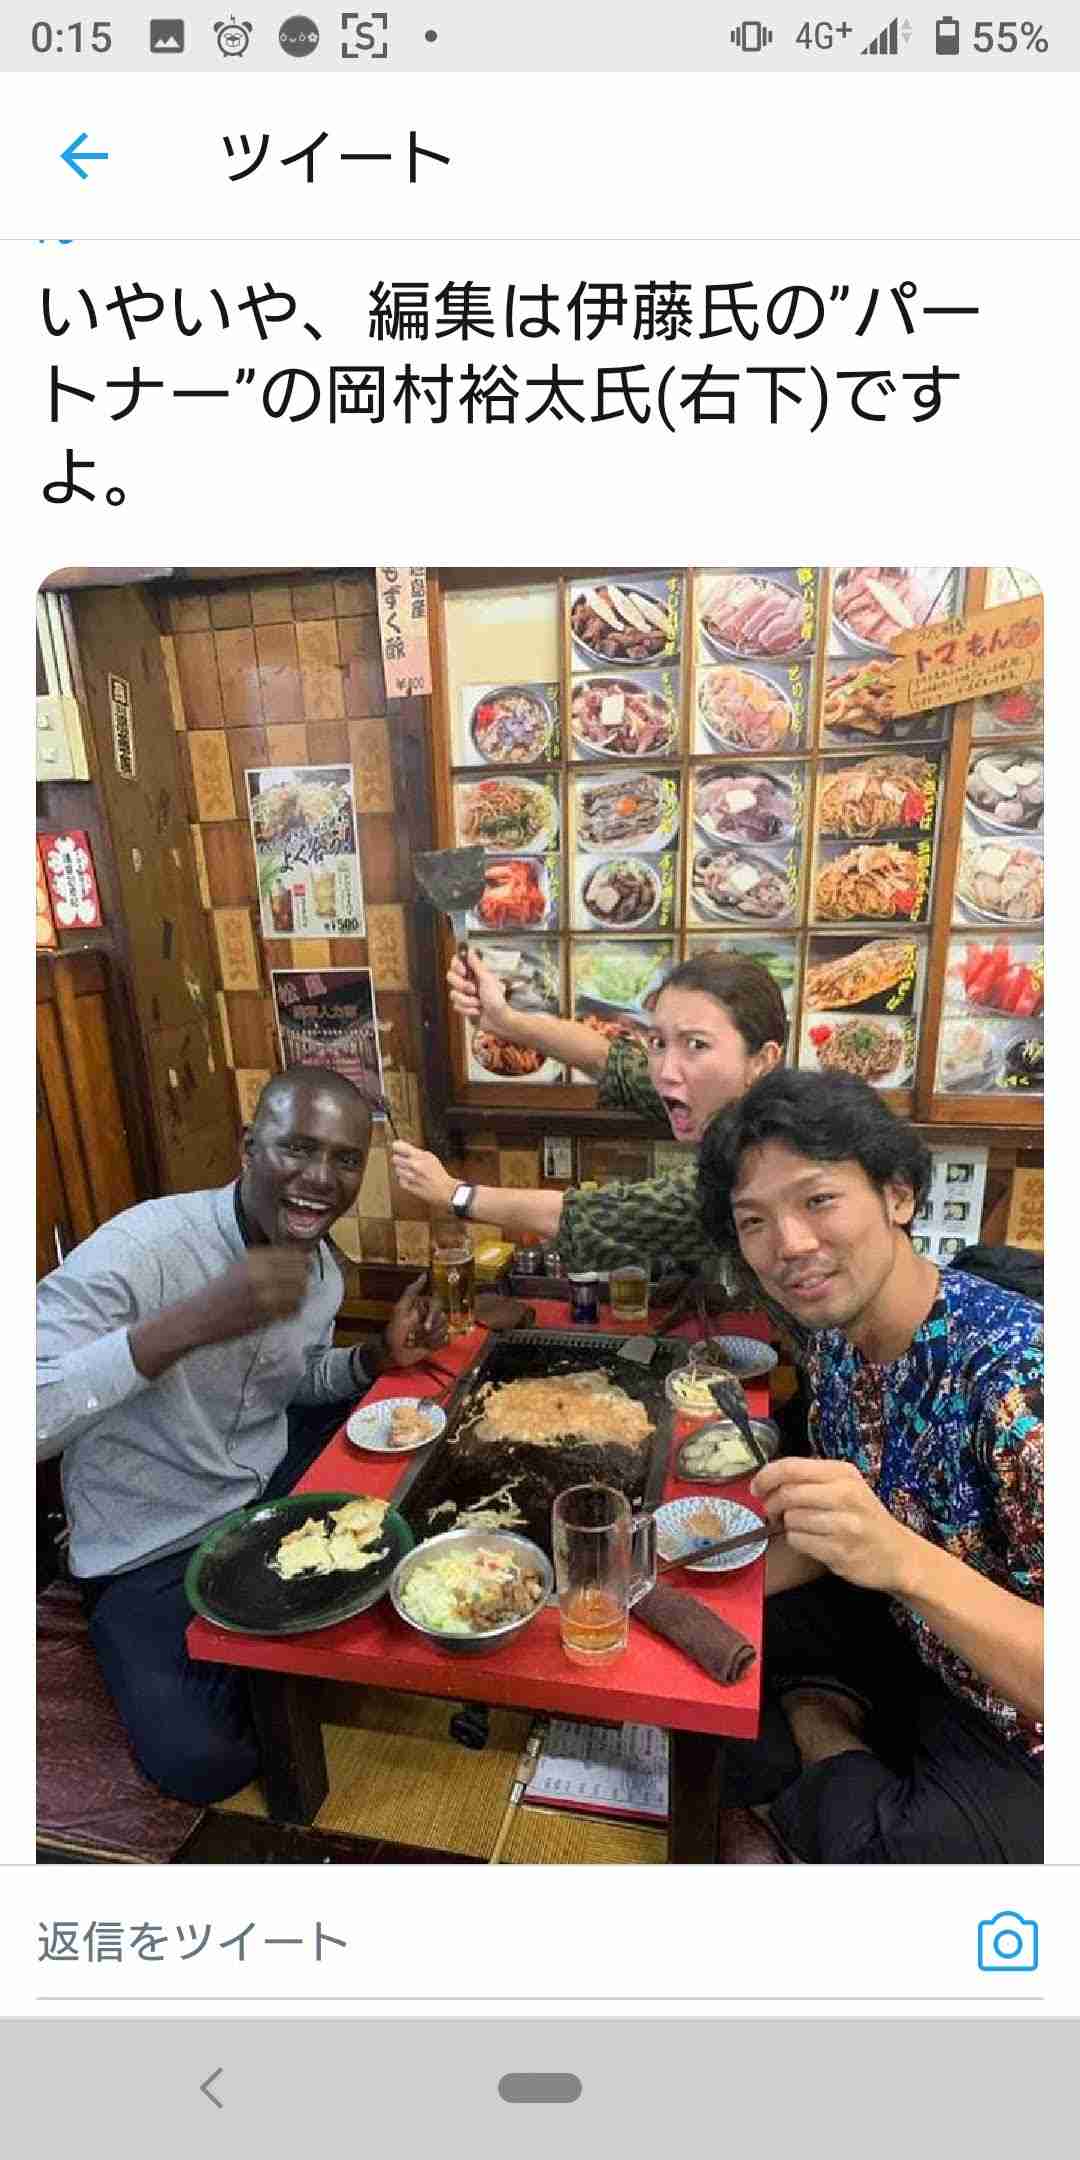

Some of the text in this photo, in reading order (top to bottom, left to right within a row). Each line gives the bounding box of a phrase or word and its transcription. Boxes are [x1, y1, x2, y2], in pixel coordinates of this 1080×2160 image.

[32, 22, 111, 52] 0:15
[796, 20, 853, 50] 4G+
[974, 21, 1048, 53] 55%
[222, 131, 450, 184] ツイート
[43, 280, 979, 341] いやいや、編集は伊藤氏の”パー
[43, 448, 125, 506] よ。
[38, 1921, 346, 1962] 返信をツイート
